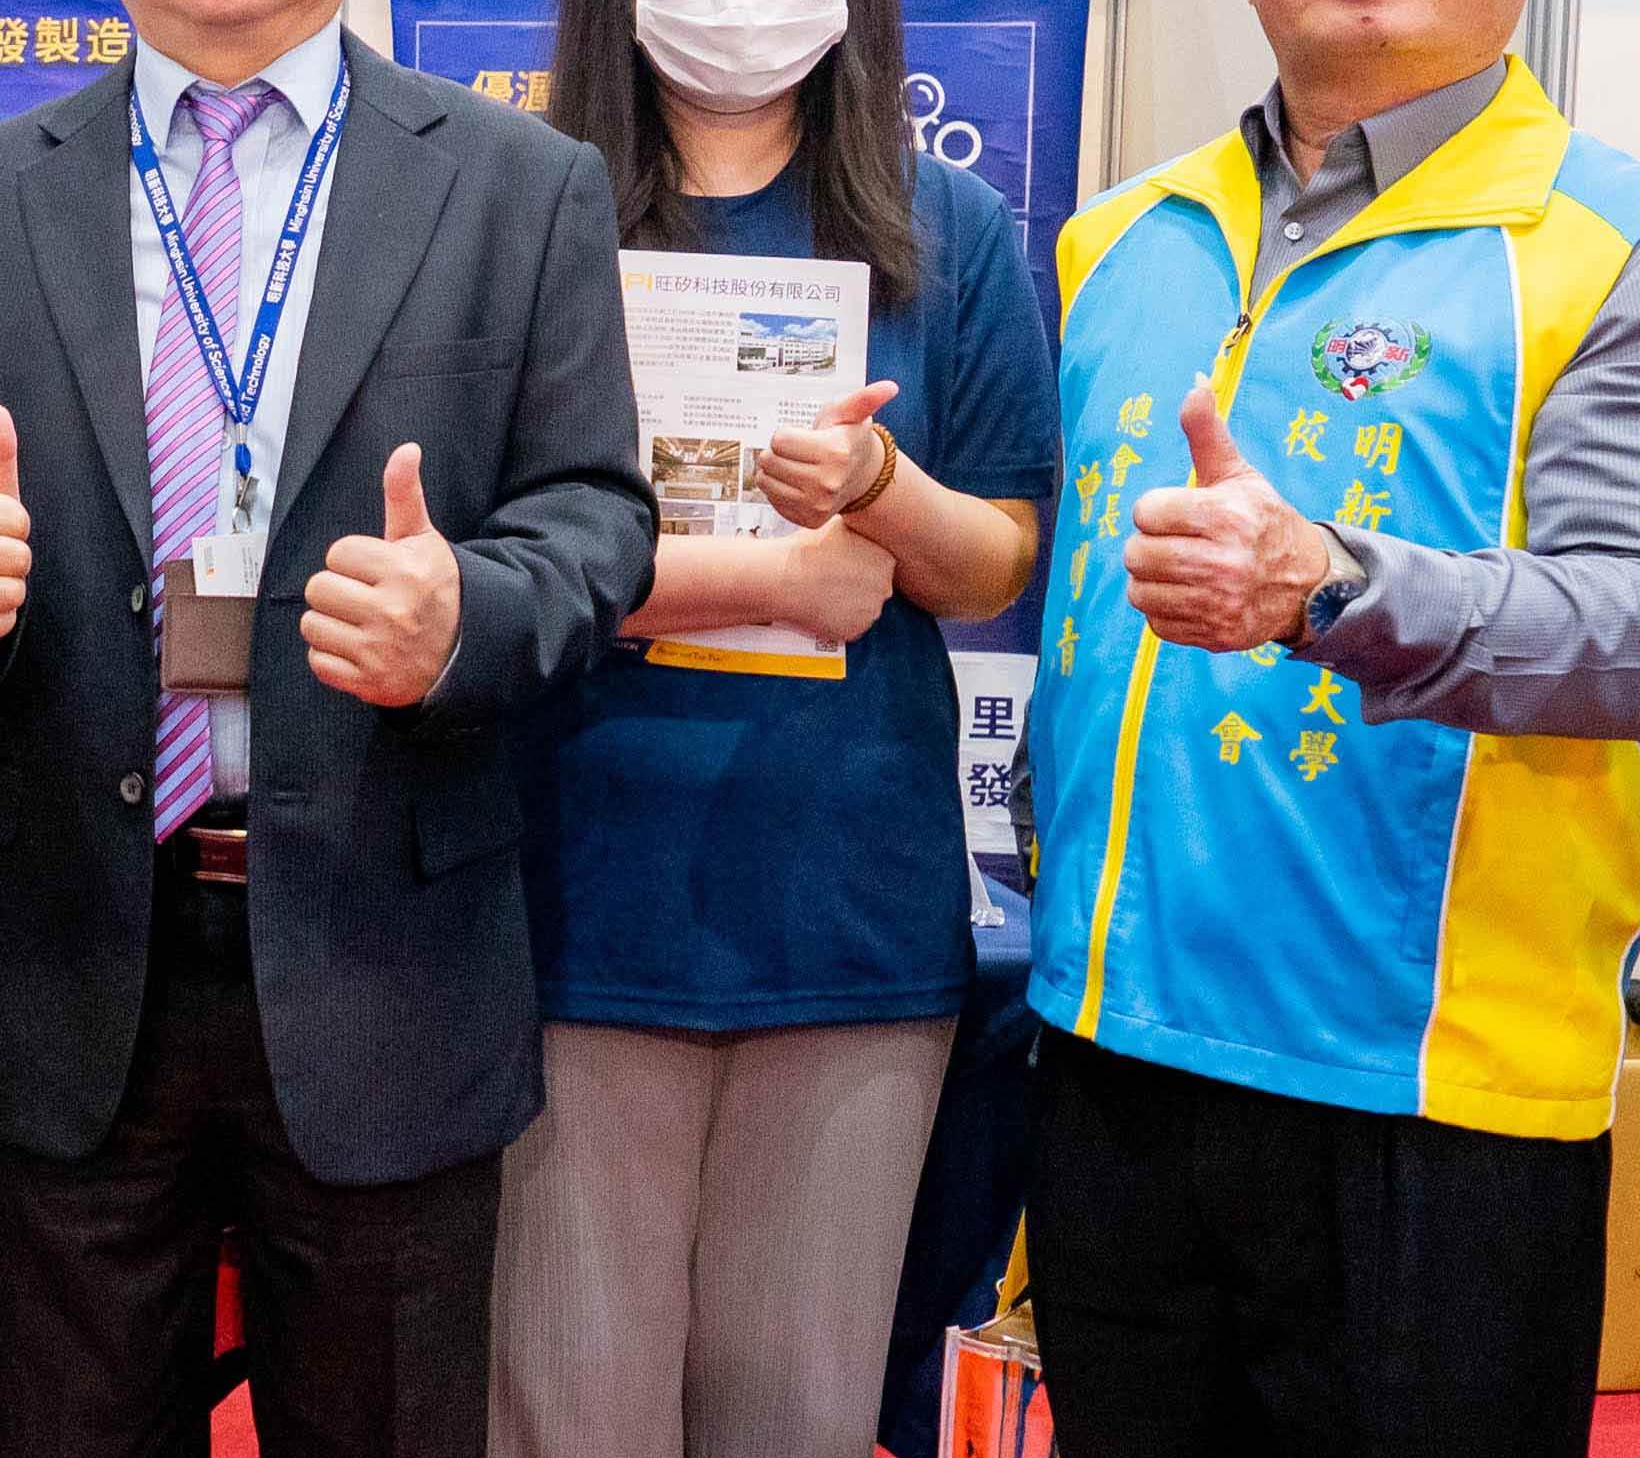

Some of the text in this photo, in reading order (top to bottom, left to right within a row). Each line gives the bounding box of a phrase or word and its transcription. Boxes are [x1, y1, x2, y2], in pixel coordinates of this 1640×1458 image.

[288, 183, 314, 234] Minghsin
[303, 133, 335, 186] University
[165, 229, 189, 279] Minghsin
[181, 275, 211, 337] University
[208, 350, 234, 399] Science
[625, 272, 842, 303] PI 旺矽科技股份有限公司
[240, 334, 272, 407] Technology
[1289, 420, 1404, 783] 明新大學
